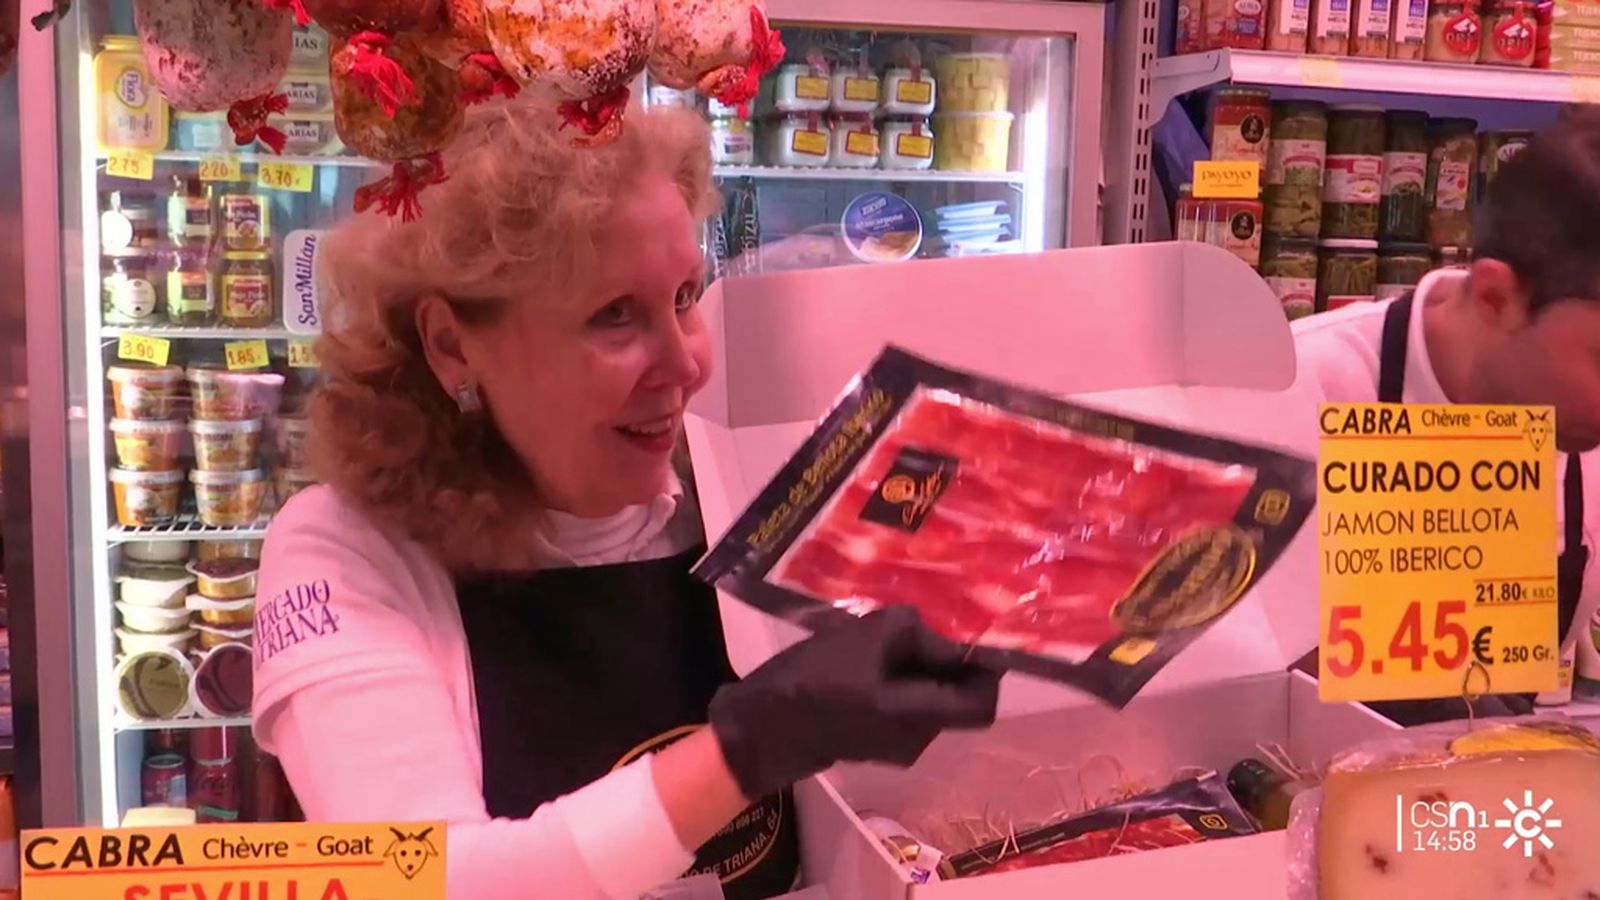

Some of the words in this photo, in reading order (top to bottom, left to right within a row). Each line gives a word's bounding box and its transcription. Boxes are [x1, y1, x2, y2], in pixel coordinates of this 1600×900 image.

[126, 73, 139, 102] Flora
[286, 90, 316, 99] ARIAS
[288, 128, 318, 138] ARIAS
[1320, 407, 1412, 435] CABRA
[1421, 408, 1471, 427] Chèvre
[1485, 410, 1518, 427] Goat
[1323, 461, 1461, 493] CURADO
[1471, 460, 1541, 492] CON
[1322, 510, 1414, 537] JAMON
[1423, 508, 1519, 534] BELLOTA
[1323, 548, 1383, 575] 100%
[1390, 545, 1483, 573] IBERICO
[1533, 586, 1555, 598] KILO
[255, 579, 330, 644] ERCADO
[1502, 646, 1528, 663] 250
[1533, 645, 1554, 661] Gr.
[24, 833, 184, 871] CABRA
[203, 836, 289, 860] Chèvre
[316, 835, 373, 856] Goat
